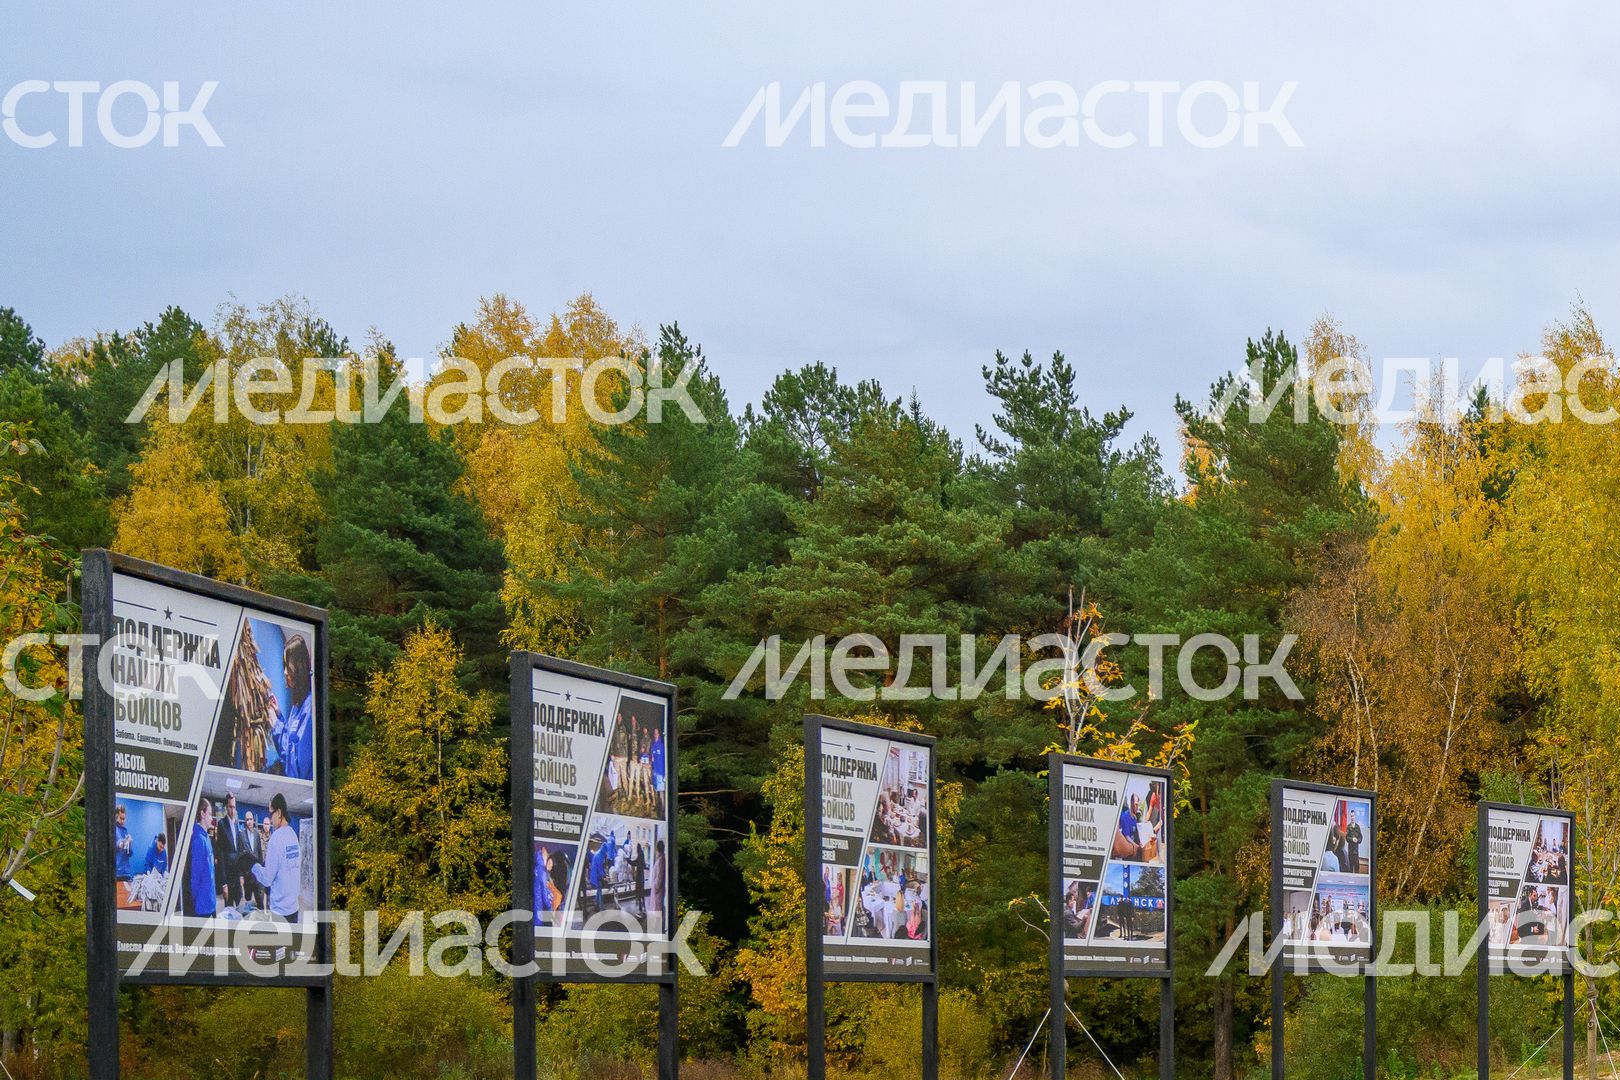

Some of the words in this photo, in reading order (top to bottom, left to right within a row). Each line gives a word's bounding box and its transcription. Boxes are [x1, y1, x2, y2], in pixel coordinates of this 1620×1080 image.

[112, 616, 221, 669] ПОДДЕРЖКА
[113, 654, 176, 695] НАШИХ
[115, 691, 182, 733] БОЙЦОВ
[533, 702, 605, 737] ПОДДЕРЖКА
[115, 752, 145, 771] РАБОТА
[822, 754, 877, 781] ПОДДЕРЖКА
[115, 770, 169, 793] ВОЛОНТЕРОВ
[1063, 784, 1118, 806] ПОДДЕРЖКА
[1064, 804, 1095, 823] НАШИХ
[1283, 807, 1327, 826] ПОДДЕРЖКА
[1064, 823, 1097, 844] БОЙЦОВ
[1488, 826, 1531, 842] ПОДДЕРЖКА
